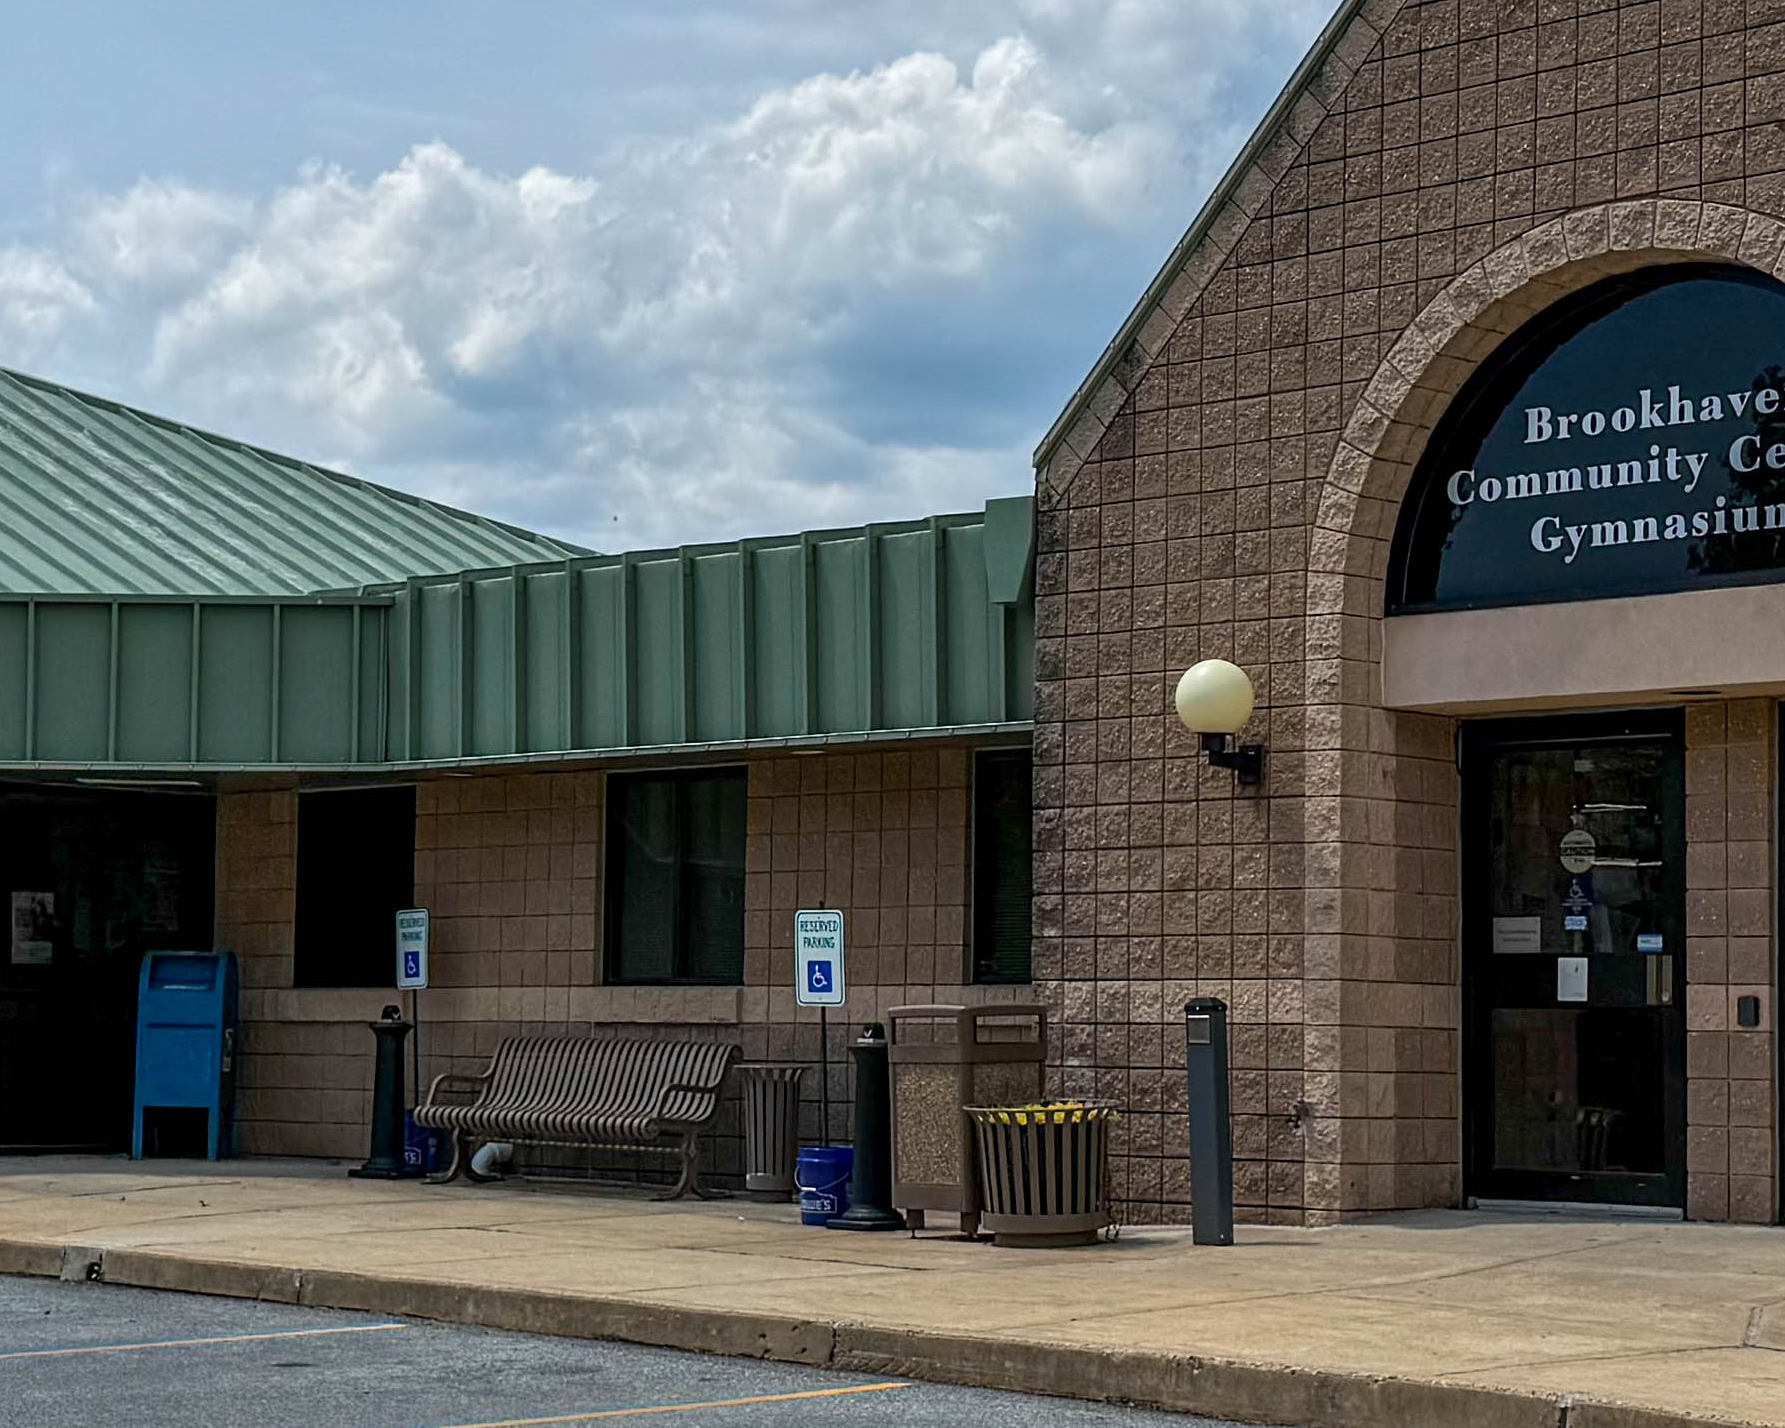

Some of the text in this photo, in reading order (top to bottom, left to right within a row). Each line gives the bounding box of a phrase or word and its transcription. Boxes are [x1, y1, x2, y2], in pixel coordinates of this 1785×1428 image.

[1447, 445, 1709, 506] Community
[800, 920, 839, 933] RESERVED
[803, 936, 835, 949] PARKING
